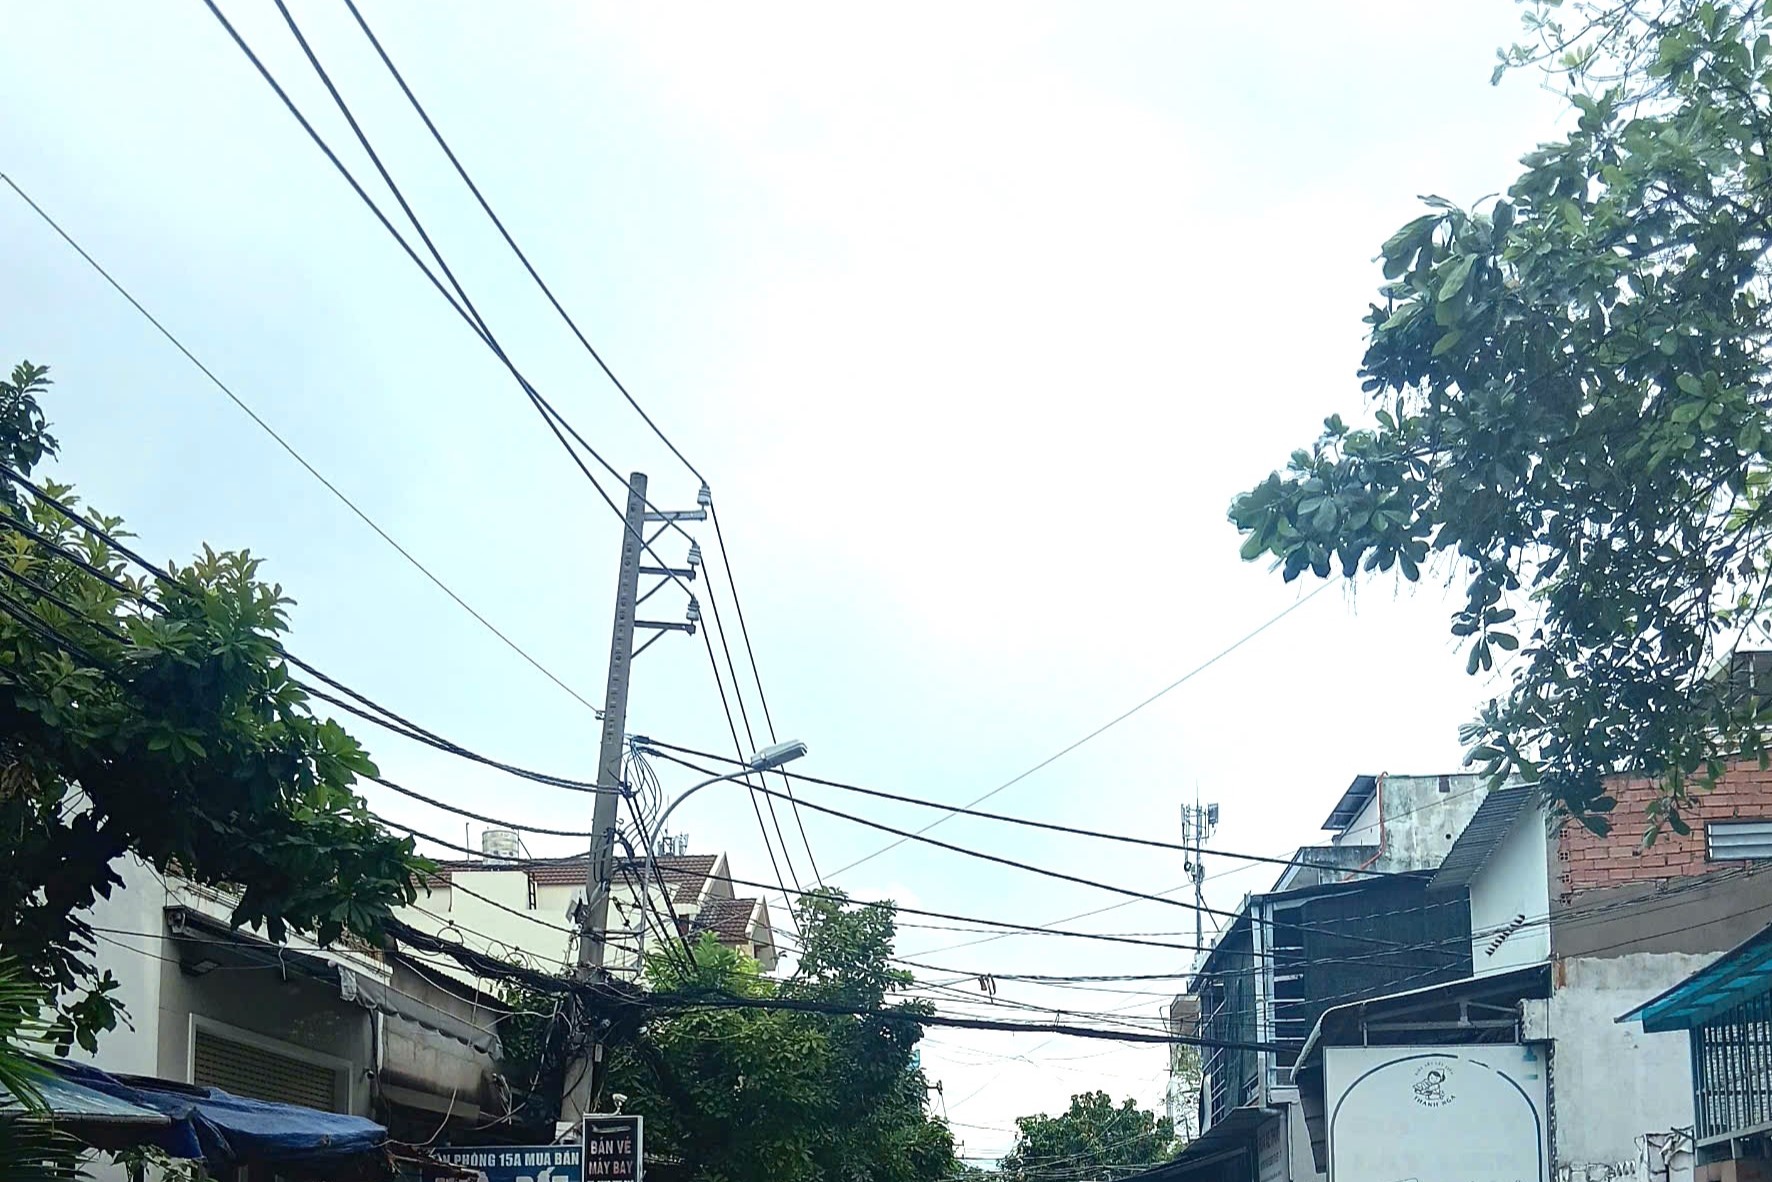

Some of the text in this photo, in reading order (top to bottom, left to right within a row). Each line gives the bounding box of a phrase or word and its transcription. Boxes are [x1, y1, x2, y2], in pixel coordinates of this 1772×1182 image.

[590, 1135, 632, 1155] BÁN VÉ
[453, 1152, 496, 1167] PHÒNG
[499, 1153, 522, 1167] 15A
[524, 1153, 551, 1167] MUA
[554, 1151, 580, 1166] BÁN
[588, 1157, 633, 1176] MÁY BAY
